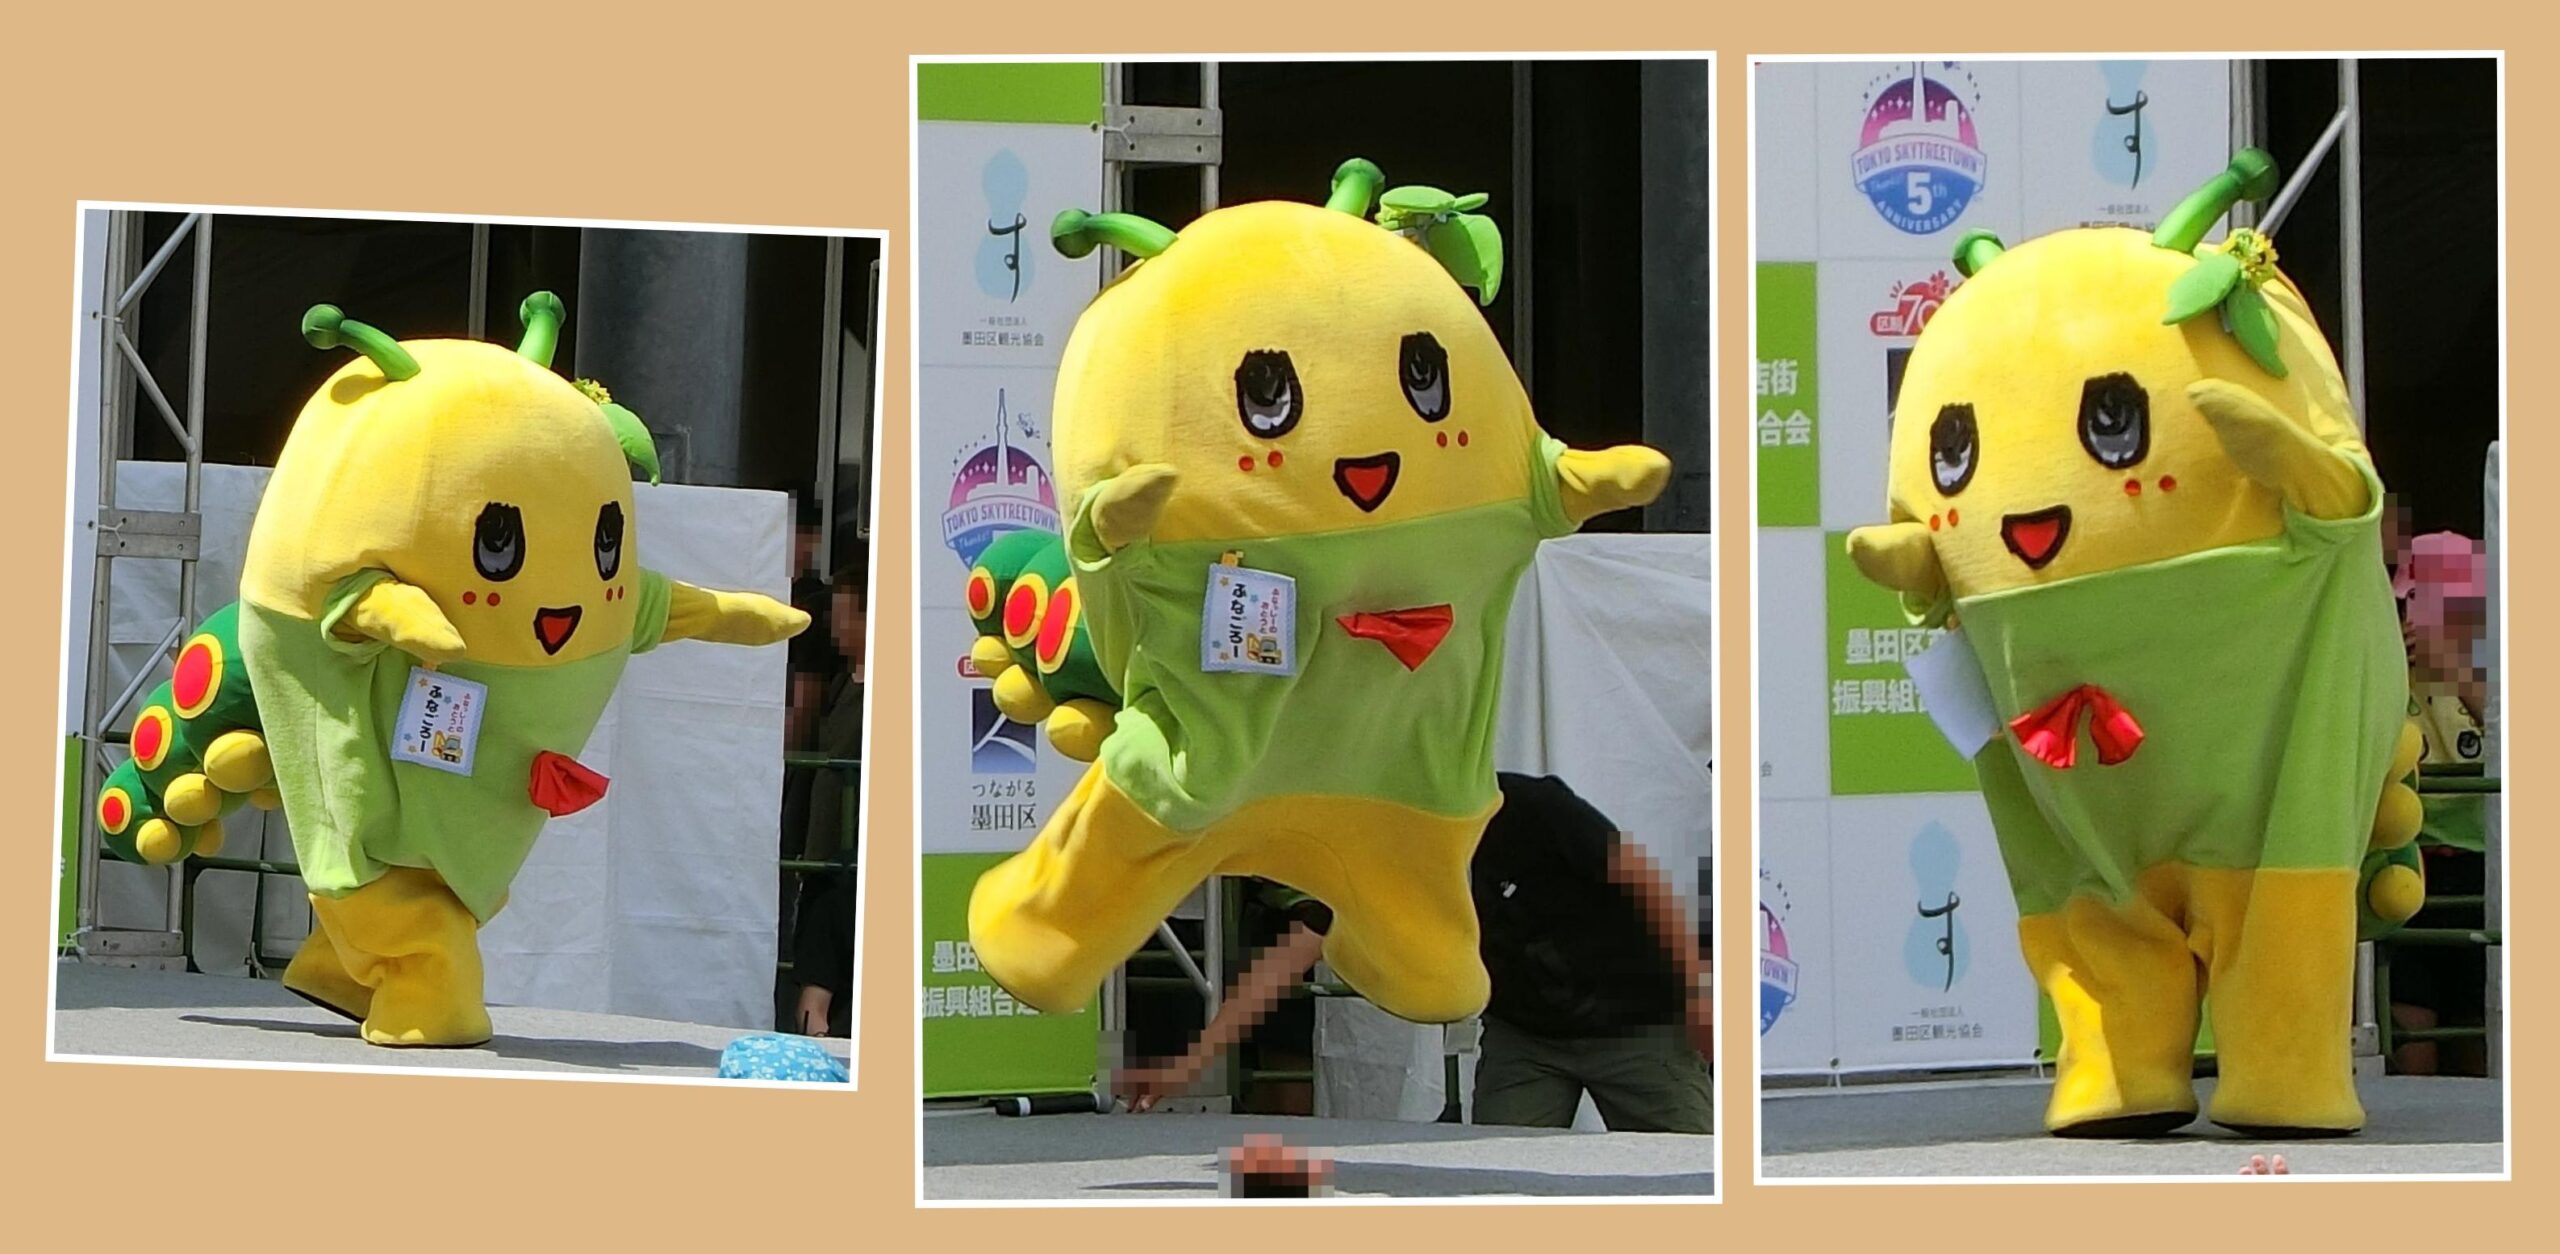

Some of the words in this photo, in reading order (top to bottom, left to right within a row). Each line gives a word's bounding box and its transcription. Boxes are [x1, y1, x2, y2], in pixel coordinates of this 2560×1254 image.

[1857, 145, 1891, 175] TOKYO
[1876, 198, 1963, 232] ANNIVERSARY
[962, 331, 1044, 347] 墨田区観光協会
[1758, 409, 1812, 446] 合会
[946, 506, 979, 534] TOKYO
[1228, 583, 1247, 659] ふなごろー
[1832, 678, 1929, 715] 振興組
[419, 684, 443, 753] ふなごろー
[972, 779, 1037, 798] つながる
[971, 803, 1038, 832] 墨田区
[1892, 1022, 1983, 1042] 墨田区観光協会
